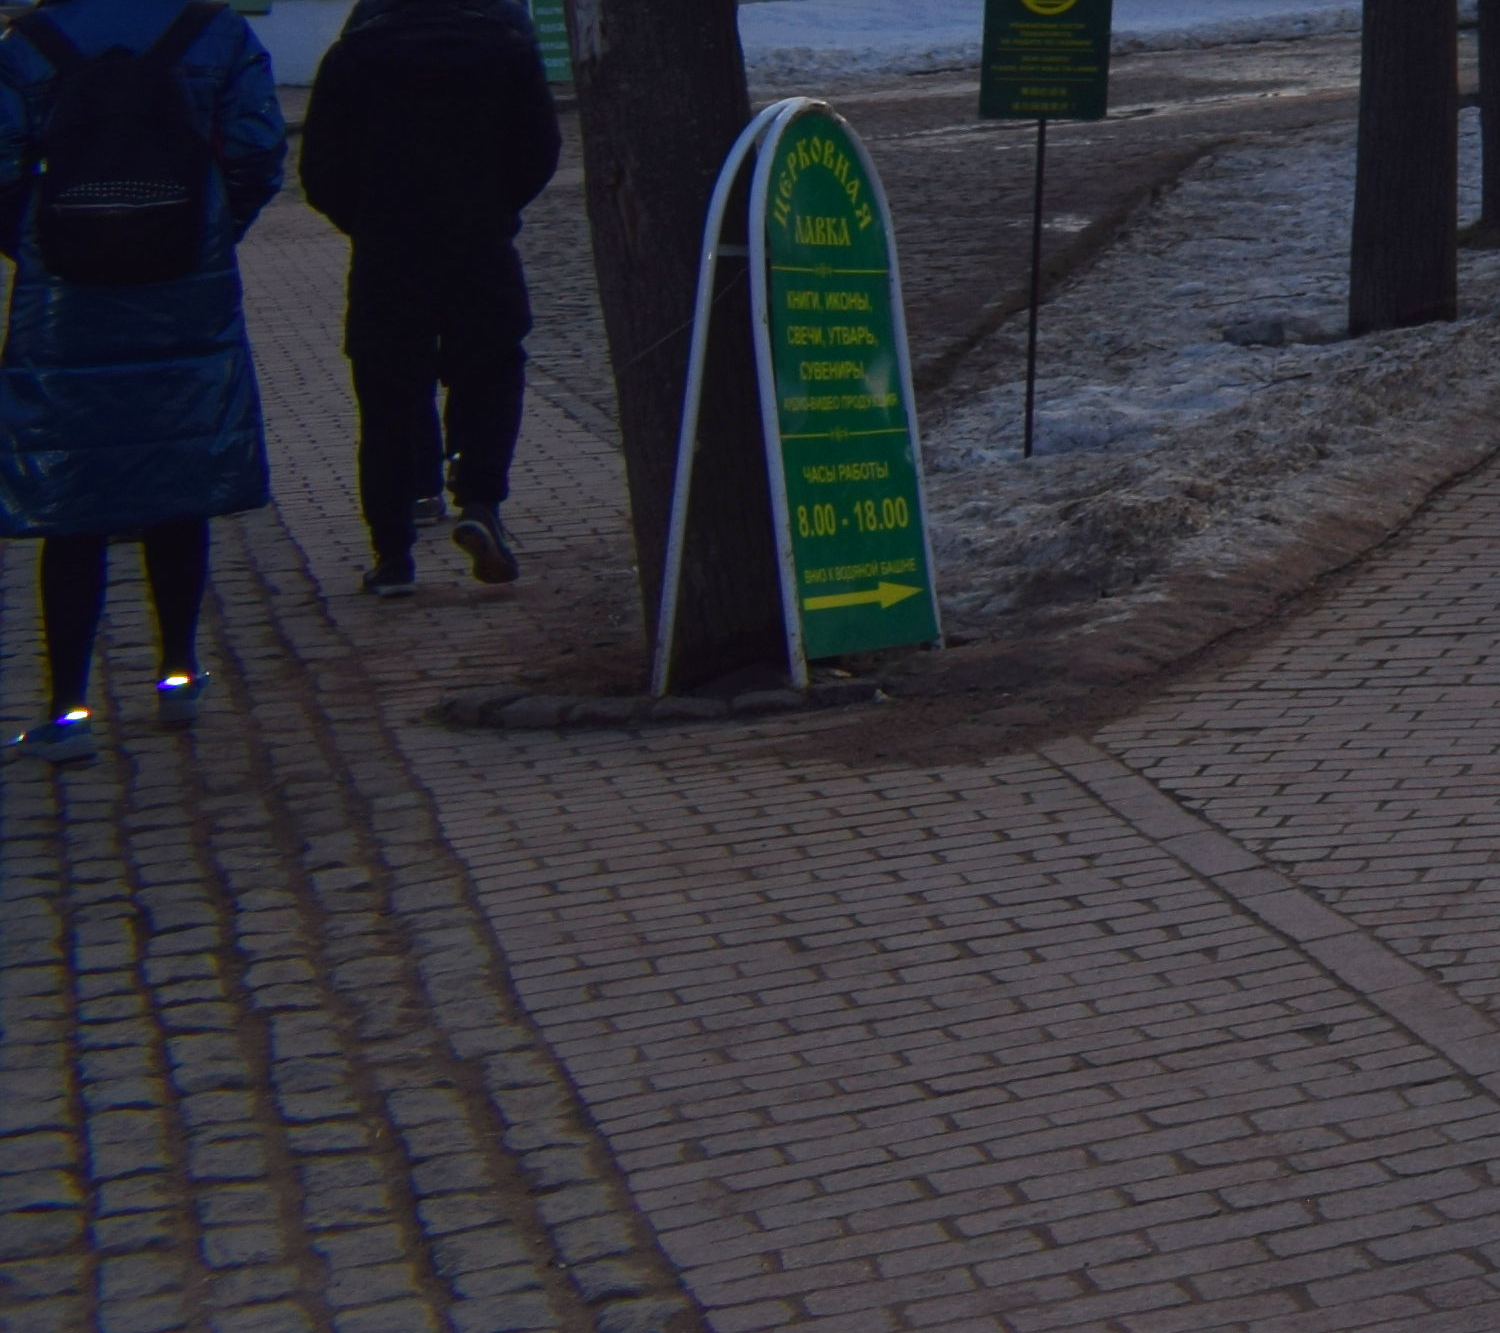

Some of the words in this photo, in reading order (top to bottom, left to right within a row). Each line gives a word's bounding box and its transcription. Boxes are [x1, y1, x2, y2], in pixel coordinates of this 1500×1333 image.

[773, 135, 872, 231] ЦЕРКОВНАЯ
[795, 215, 851, 246] ЛАВКА
[786, 290, 824, 312] КНИГИ,
[825, 291, 873, 313] ИКОНЫ,
[786, 325, 826, 348] СВЕЧИ,
[828, 325, 879, 347] УТВАРЬ,
[802, 464, 836, 484] ЧАСЫ
[838, 461, 889, 482] РАБОТЫ
[797, 503, 836, 538] 8.00
[842, 518, 850, 526] -
[853, 495, 909, 533] 18.00
